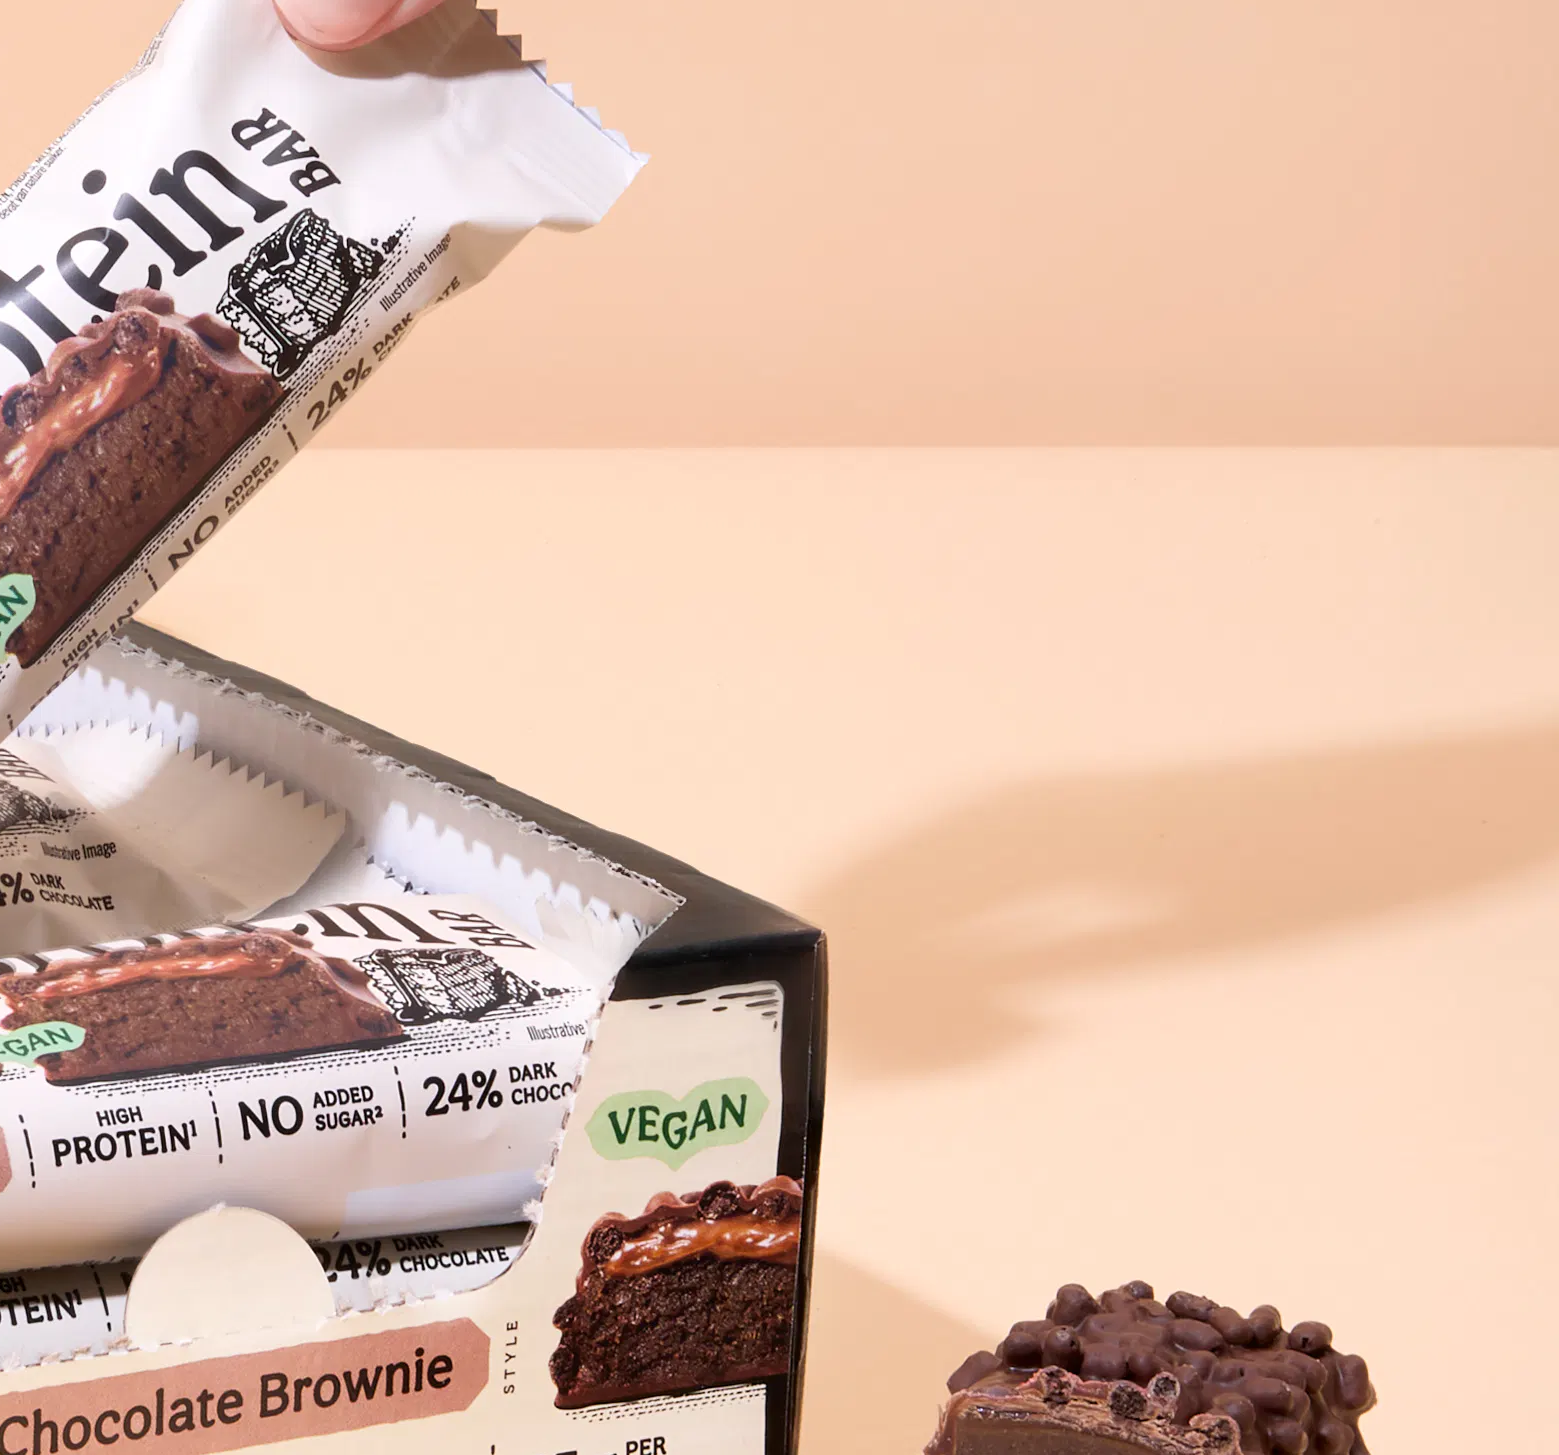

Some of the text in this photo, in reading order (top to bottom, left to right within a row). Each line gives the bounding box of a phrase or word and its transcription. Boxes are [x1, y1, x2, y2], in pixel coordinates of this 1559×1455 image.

[231, 108, 341, 197] BAR
[379, 233, 451, 313] Illustrative Image
[307, 312, 414, 431] 24% DARK
[167, 455, 271, 572] NO ADDED
[62, 628, 98, 667] HIGH
[83, 841, 116, 860] Image
[30, 871, 65, 890] DARK
[39, 889, 115, 911] CHOCOLATE
[526, 1021, 586, 1041] Illustrative
[96, 1105, 143, 1126] HIGH
[314, 1062, 557, 1131] SUGAR² 24% DARK
[607, 1093, 749, 1150] VEGAN
[51, 1085, 374, 1167] PROTEIN¹ NO ADDED
[391, 1235, 444, 1252] DARK
[400, 1246, 509, 1273] CHOCOLATE
[258, 1346, 454, 1418] Brownie
[504, 1320, 518, 1394] STYLE
